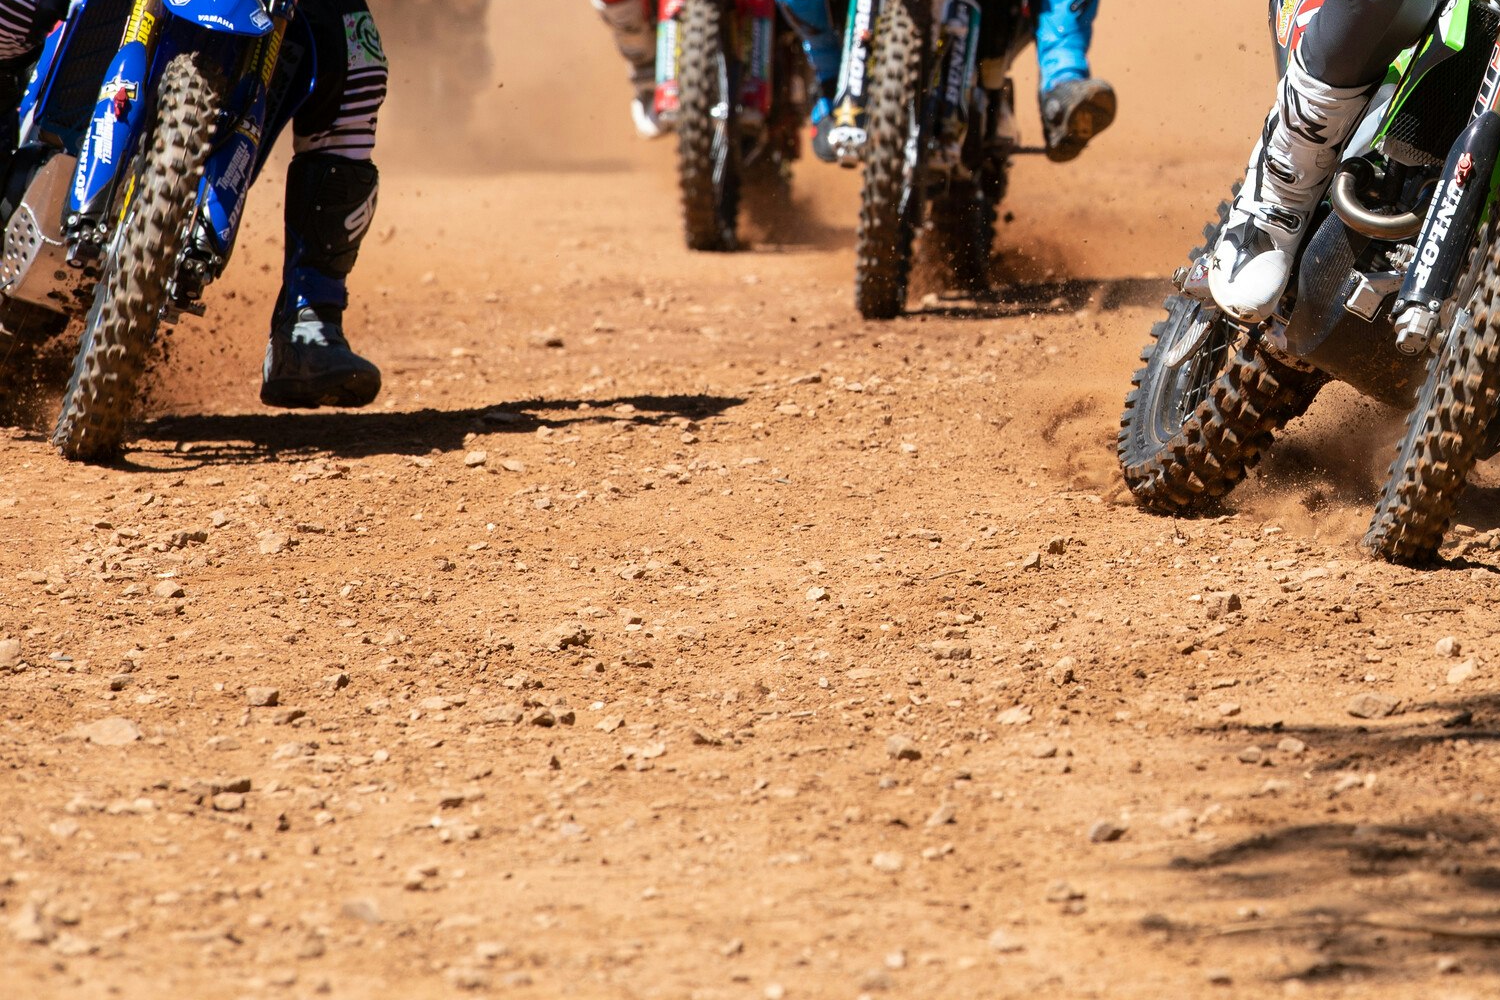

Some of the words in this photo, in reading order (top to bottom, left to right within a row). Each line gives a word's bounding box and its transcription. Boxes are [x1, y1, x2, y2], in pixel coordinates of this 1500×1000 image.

[197, 14, 235, 31] YAMAHA
[215, 140, 249, 191] TRAMMELL
[1411, 155, 1471, 294] UNLOP
